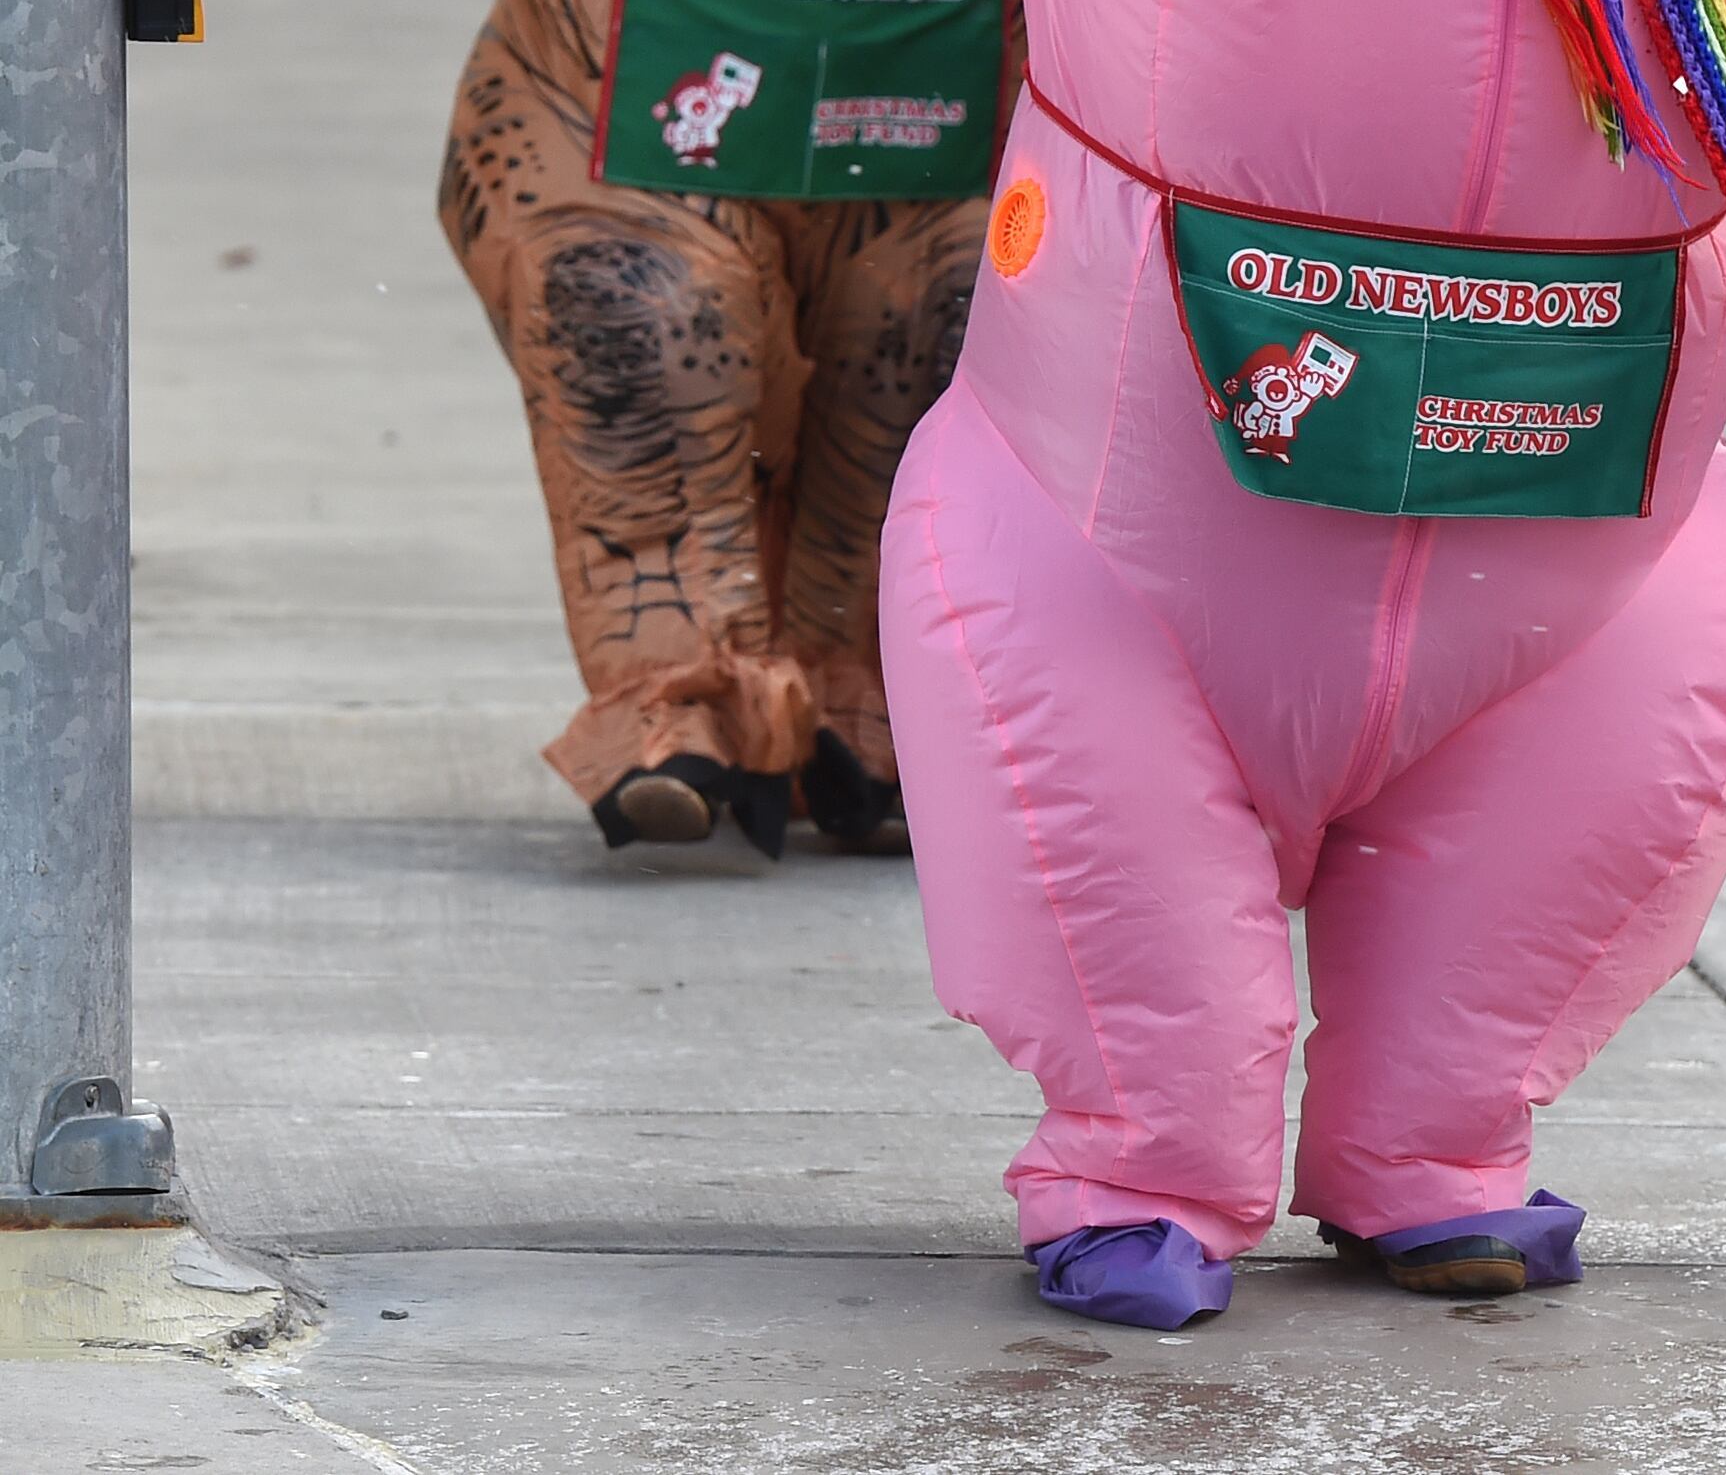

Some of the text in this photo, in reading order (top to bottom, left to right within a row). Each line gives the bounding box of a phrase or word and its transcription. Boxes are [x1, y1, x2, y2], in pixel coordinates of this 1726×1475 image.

[813, 96, 967, 126] CHRISTMAS
[1227, 247, 1623, 328] OLD NEWSBOYS
[1416, 395, 1603, 429] CHRISTMAS
[1414, 425, 1571, 456] TOY FUND
